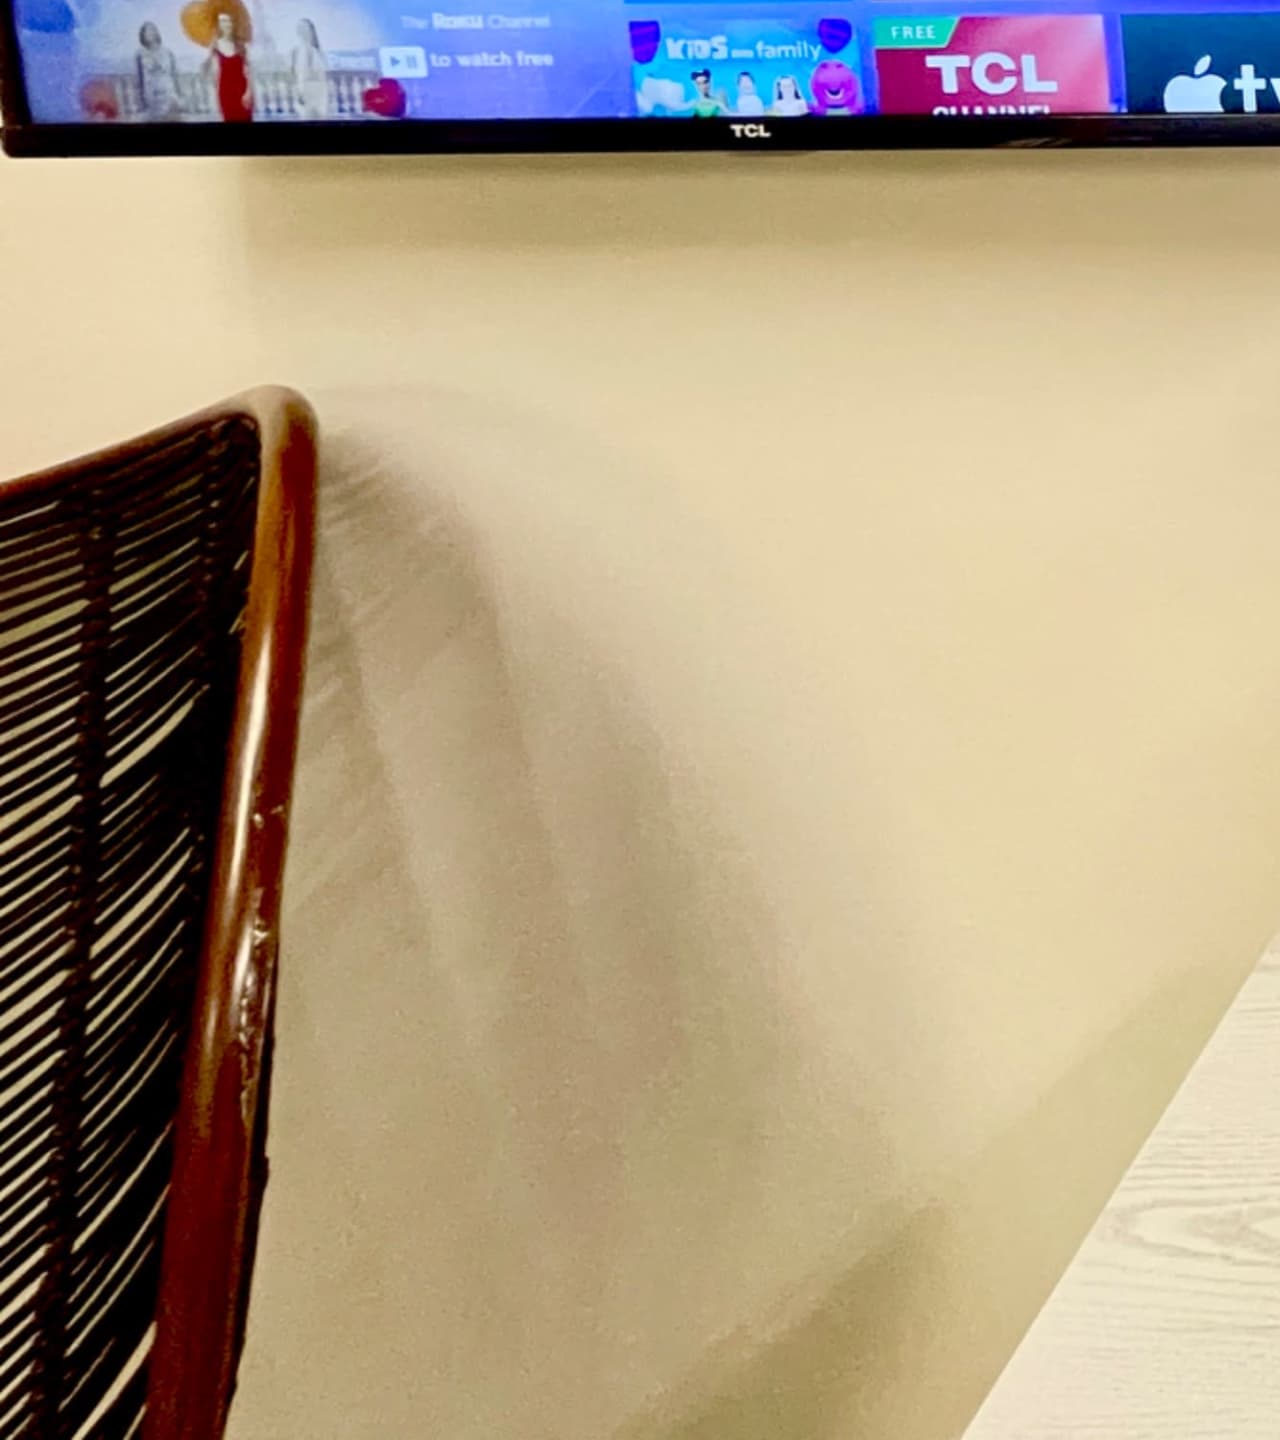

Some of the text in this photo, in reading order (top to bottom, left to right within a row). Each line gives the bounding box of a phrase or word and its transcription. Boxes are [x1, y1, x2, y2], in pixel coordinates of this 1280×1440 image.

[891, 25, 936, 40] FREE
[756, 41, 822, 62] family
[458, 52, 512, 67] watch
[925, 51, 1058, 95] TCL
[730, 124, 771, 138] TCL
